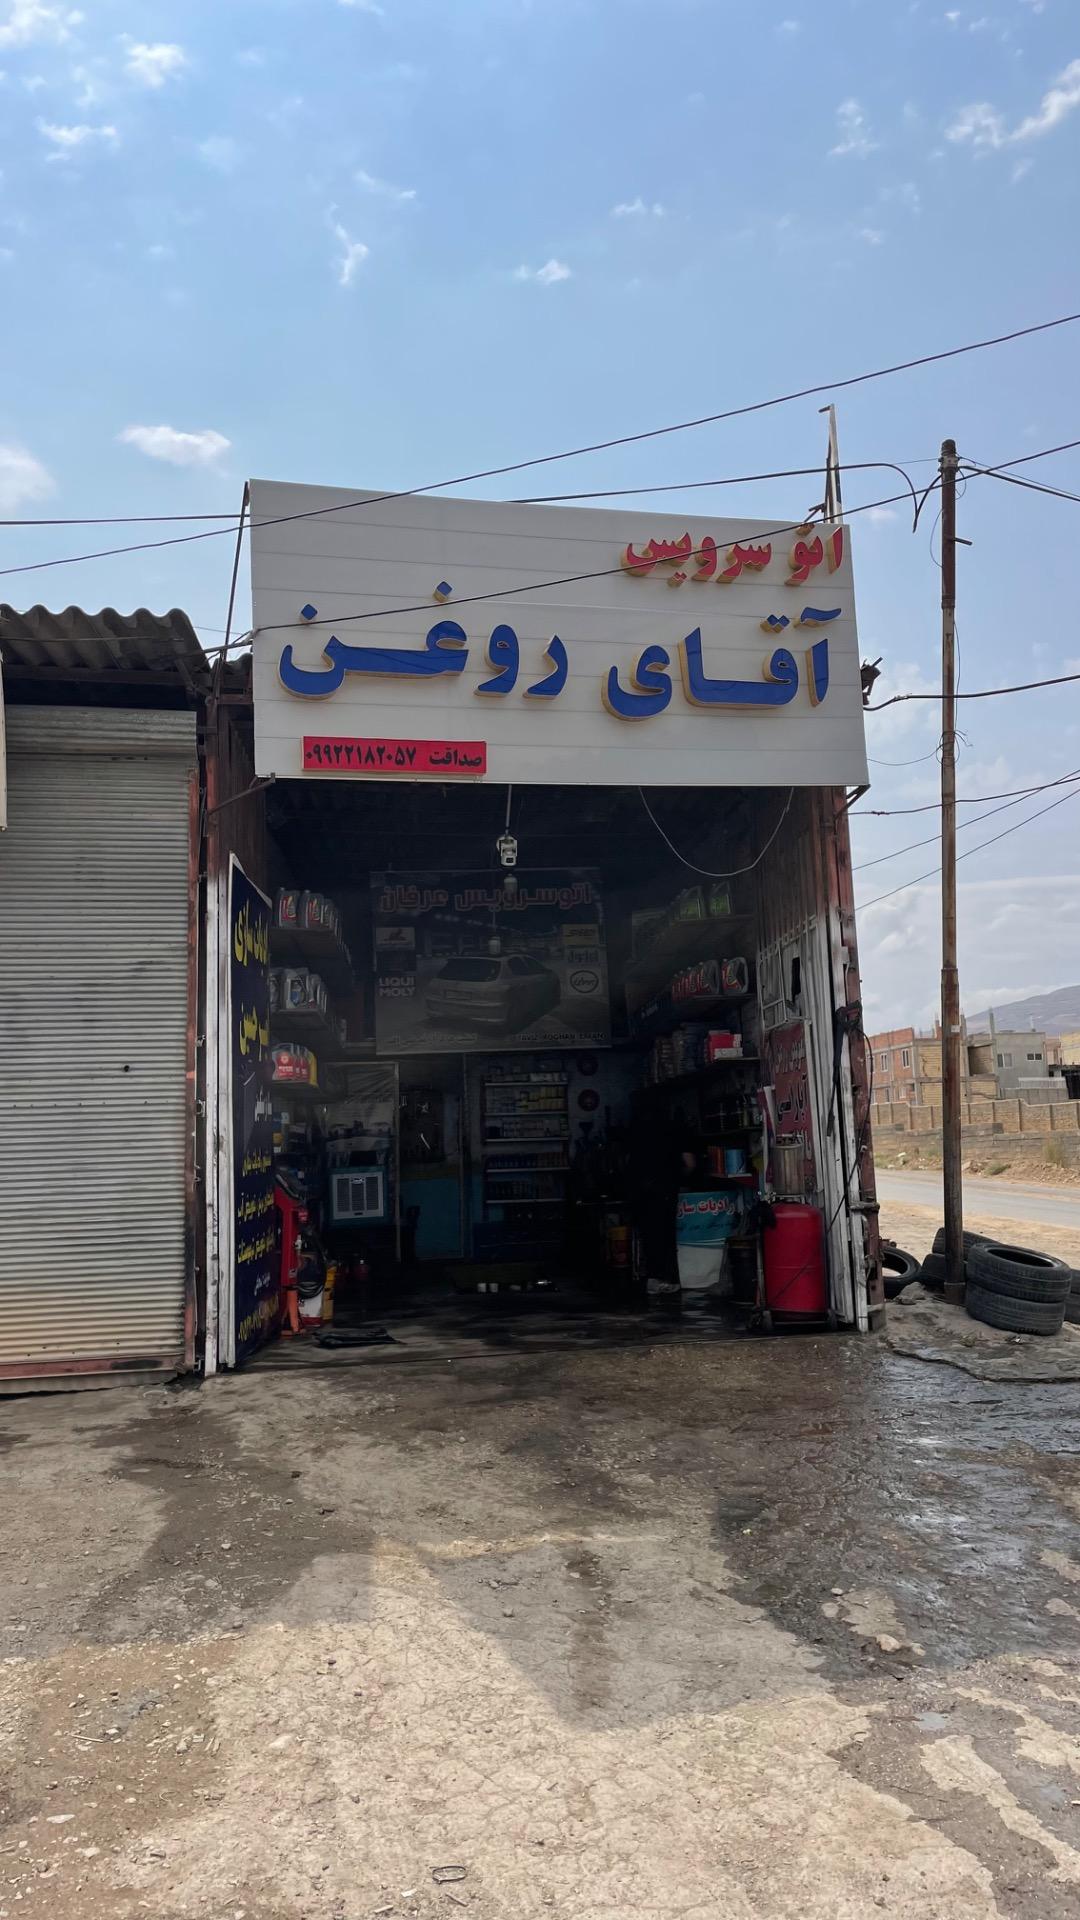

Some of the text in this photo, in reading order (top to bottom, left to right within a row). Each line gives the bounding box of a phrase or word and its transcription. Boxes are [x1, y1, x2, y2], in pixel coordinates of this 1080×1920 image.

[621, 532, 772, 588] سرویس
[278, 580, 842, 722] آقای روغن
[429, 748, 482, 767] صداقت
[379, 976, 415, 986] LIQUI
[379, 986, 415, 997] MOLY
